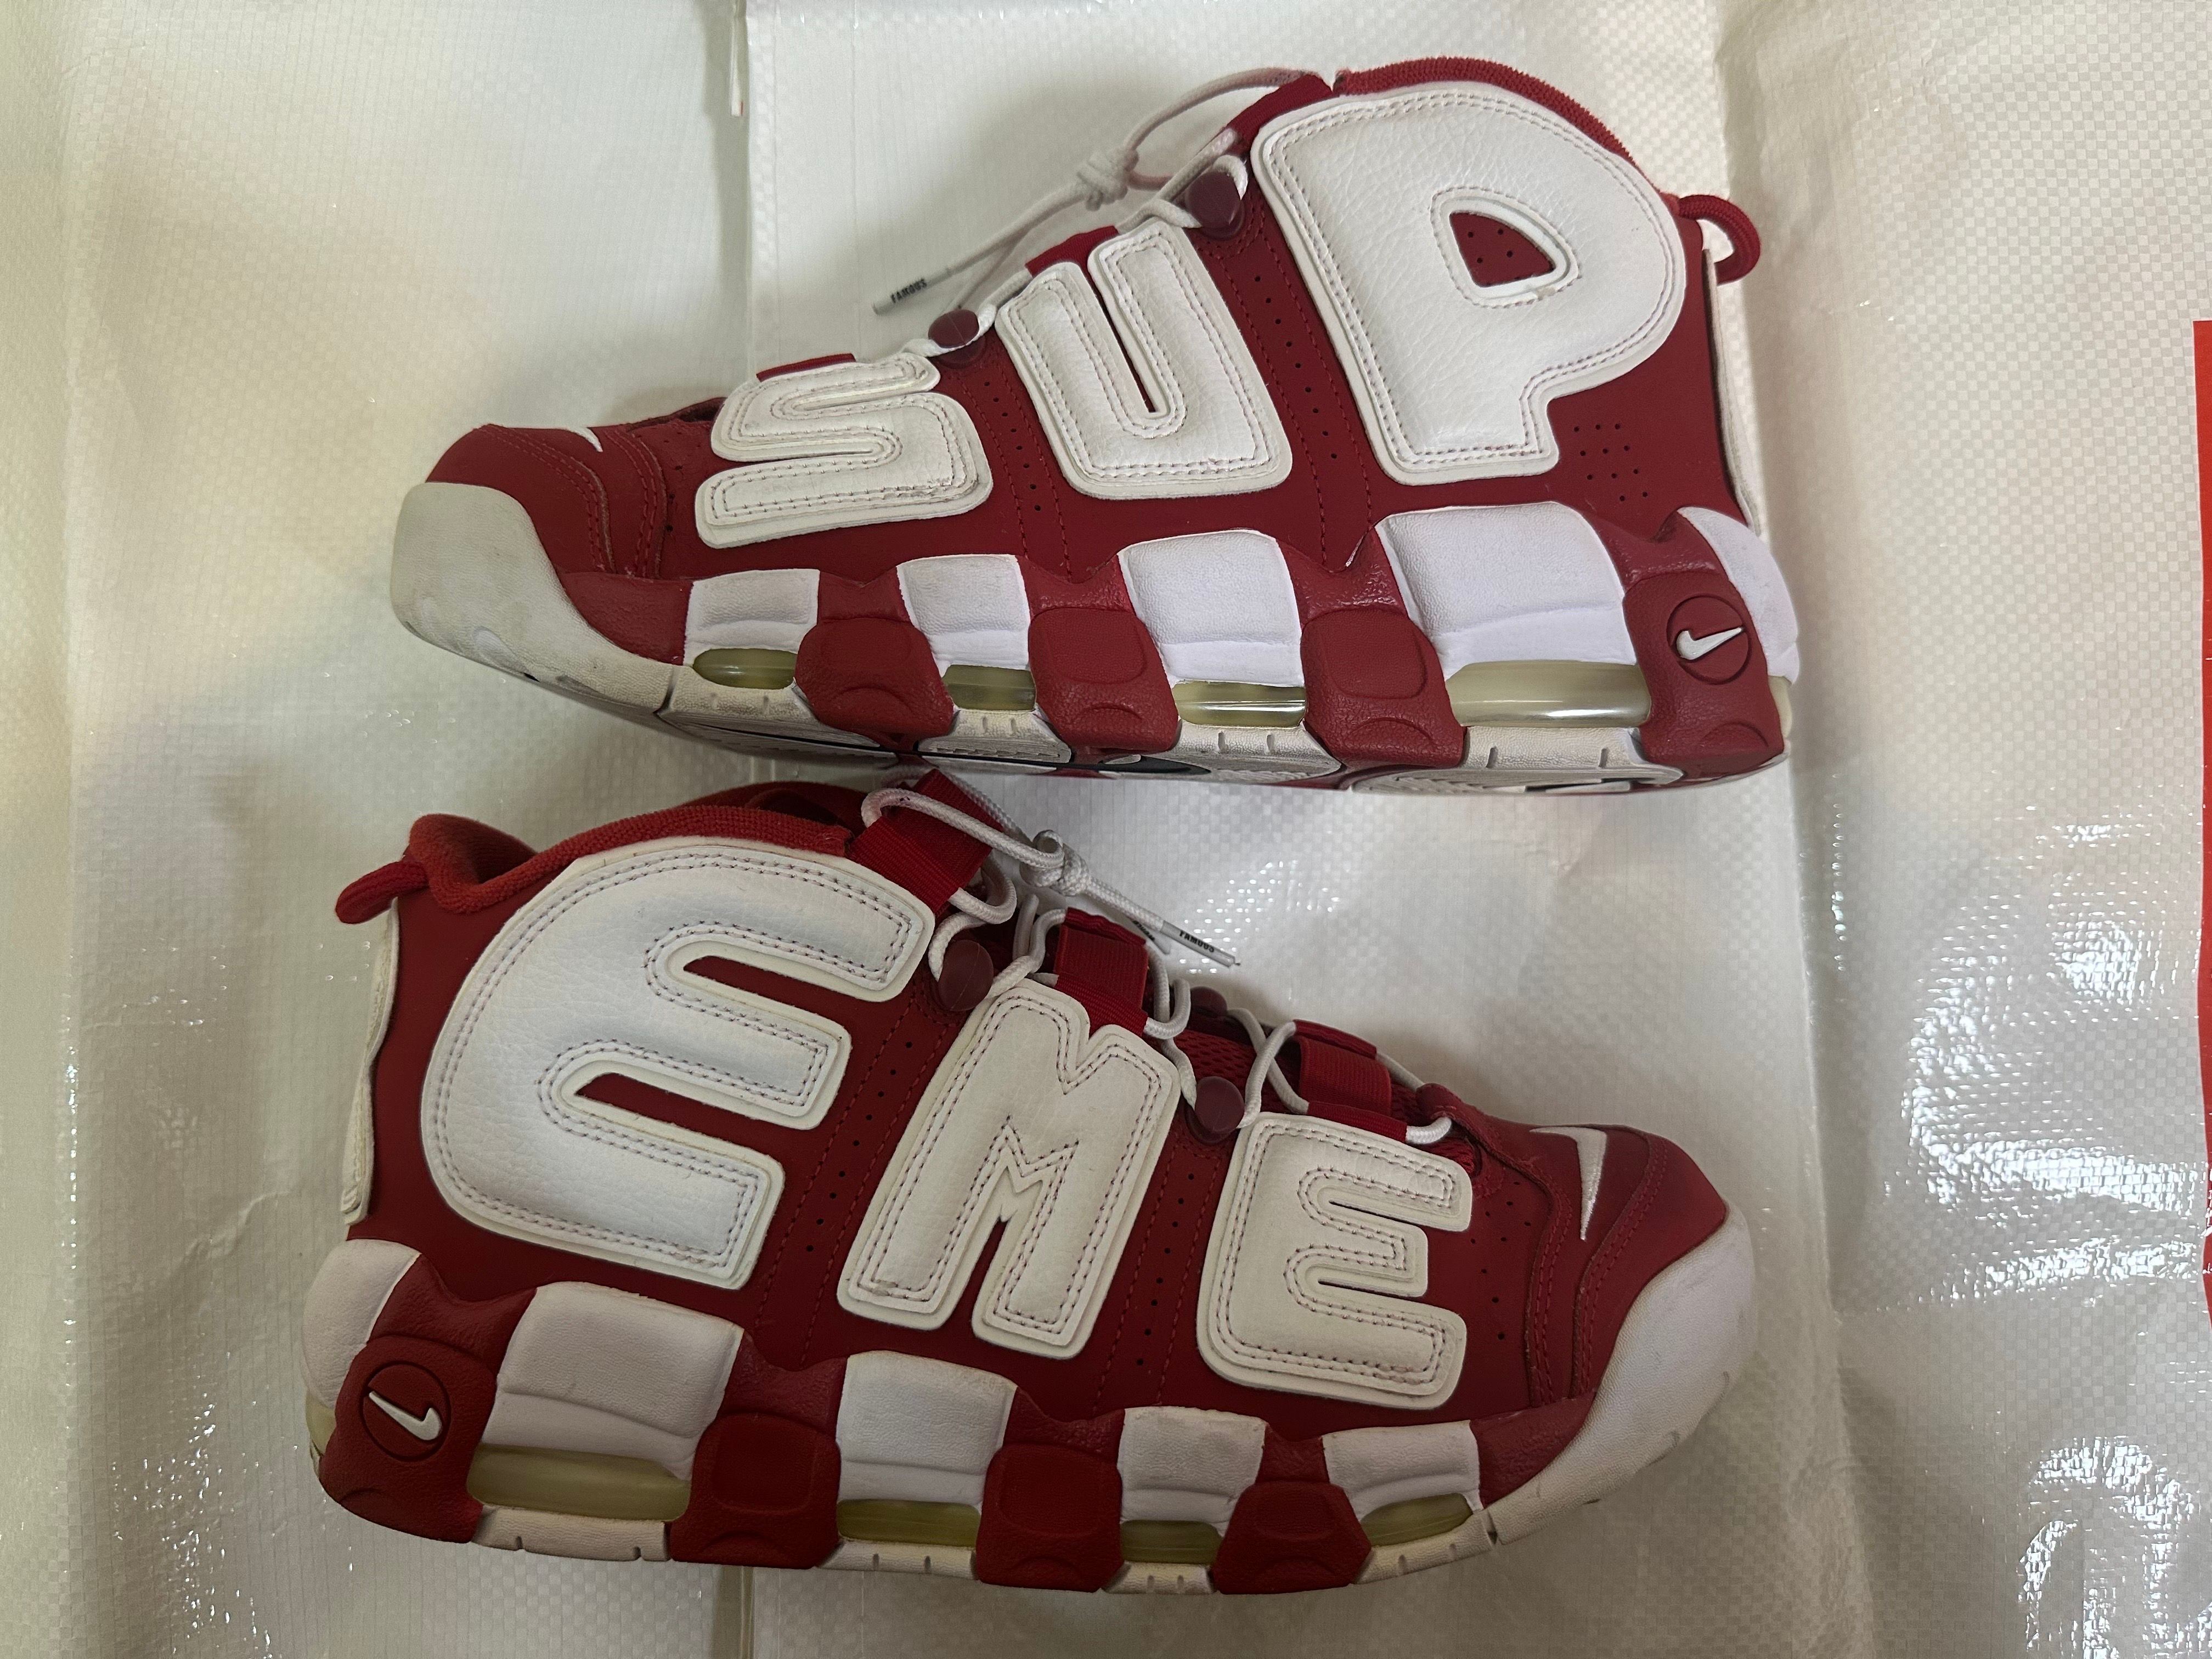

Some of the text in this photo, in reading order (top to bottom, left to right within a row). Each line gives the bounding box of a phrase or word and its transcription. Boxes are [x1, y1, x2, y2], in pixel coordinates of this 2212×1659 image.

[695, 81, 1686, 549] SUP
[890, 277, 928, 304] FAMOUS
[421, 835, 1472, 1410] EME
